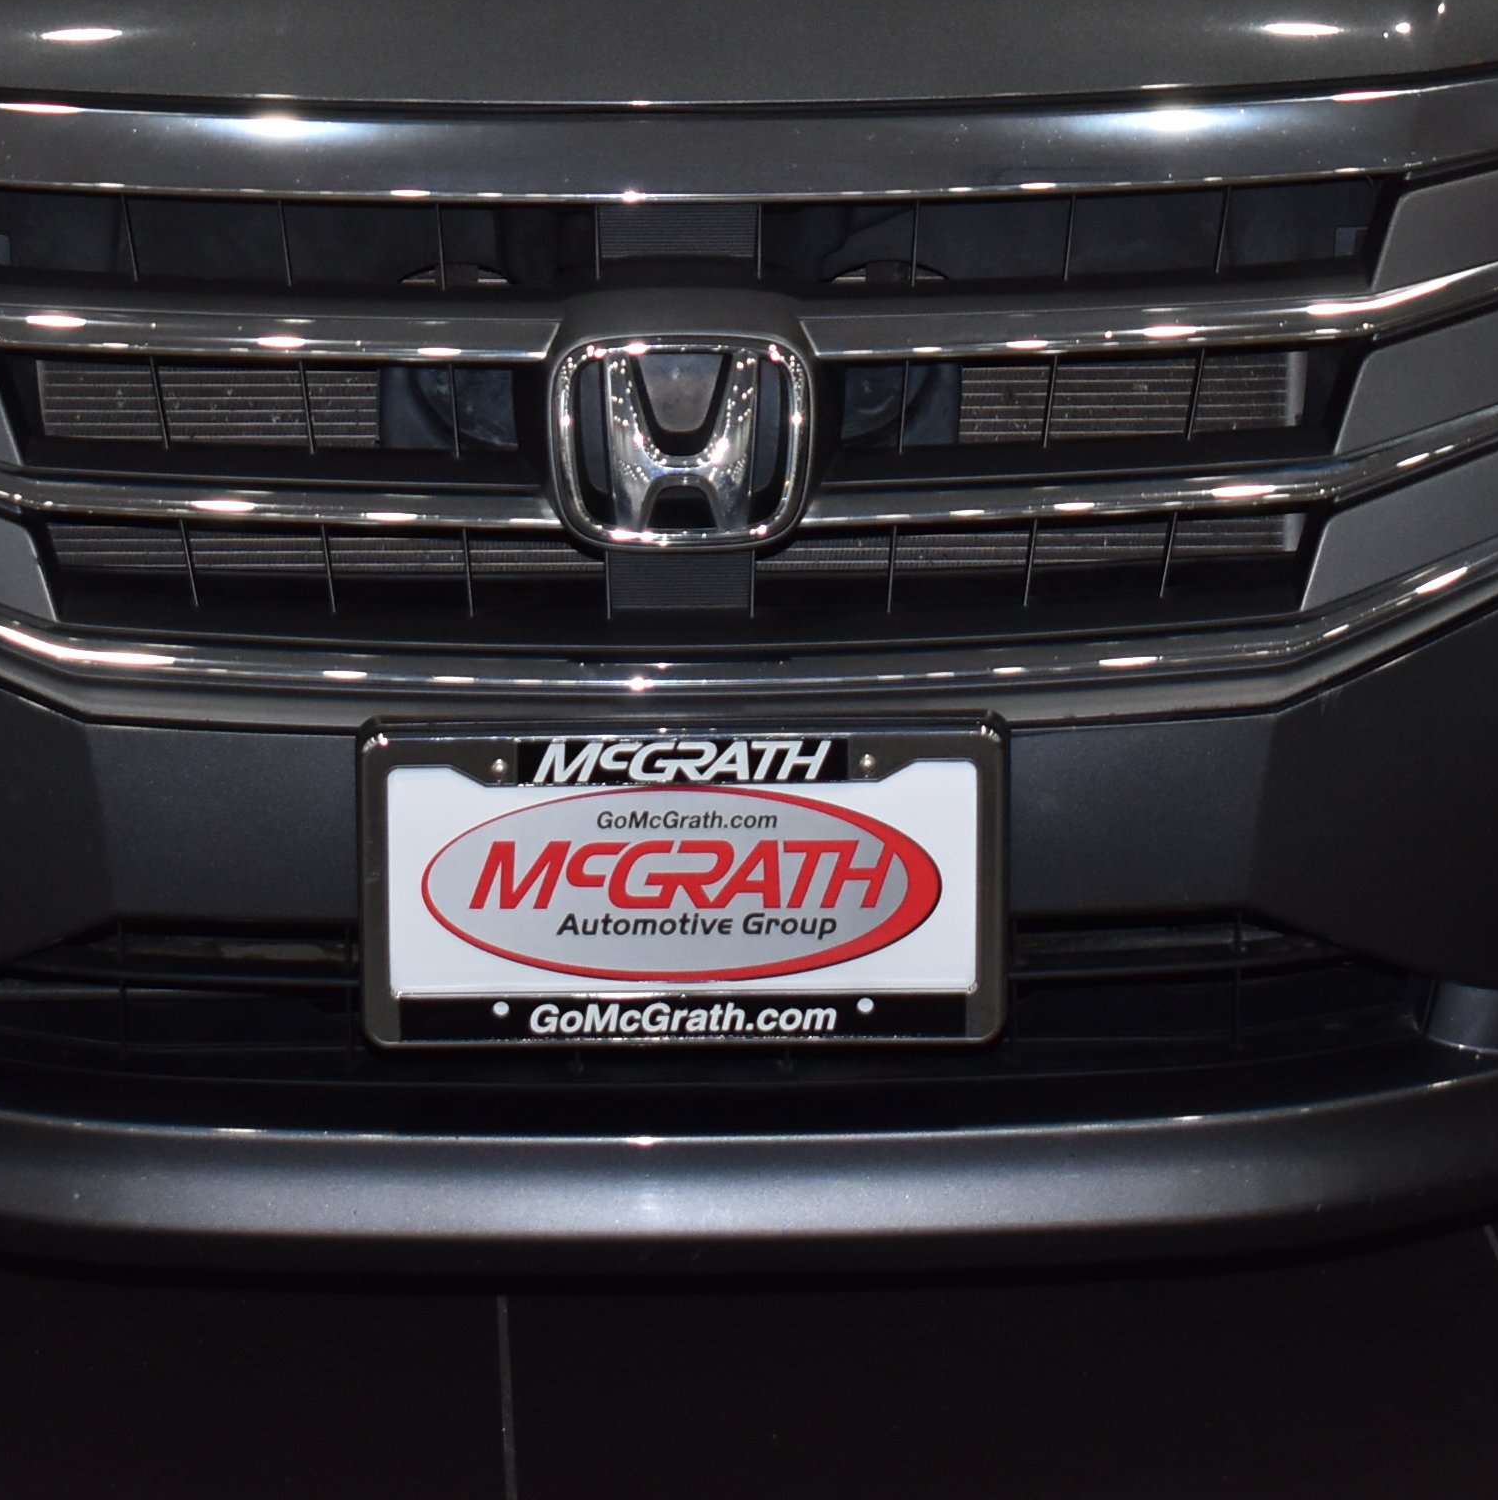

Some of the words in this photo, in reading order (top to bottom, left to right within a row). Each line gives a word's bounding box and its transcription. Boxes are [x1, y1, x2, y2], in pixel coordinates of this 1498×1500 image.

[596, 809, 778, 831] GoMcGrath.com
[555, 912, 733, 937] Automotive
[741, 912, 837, 941] Group
[528, 1002, 837, 1035] GoMcGrath.com
